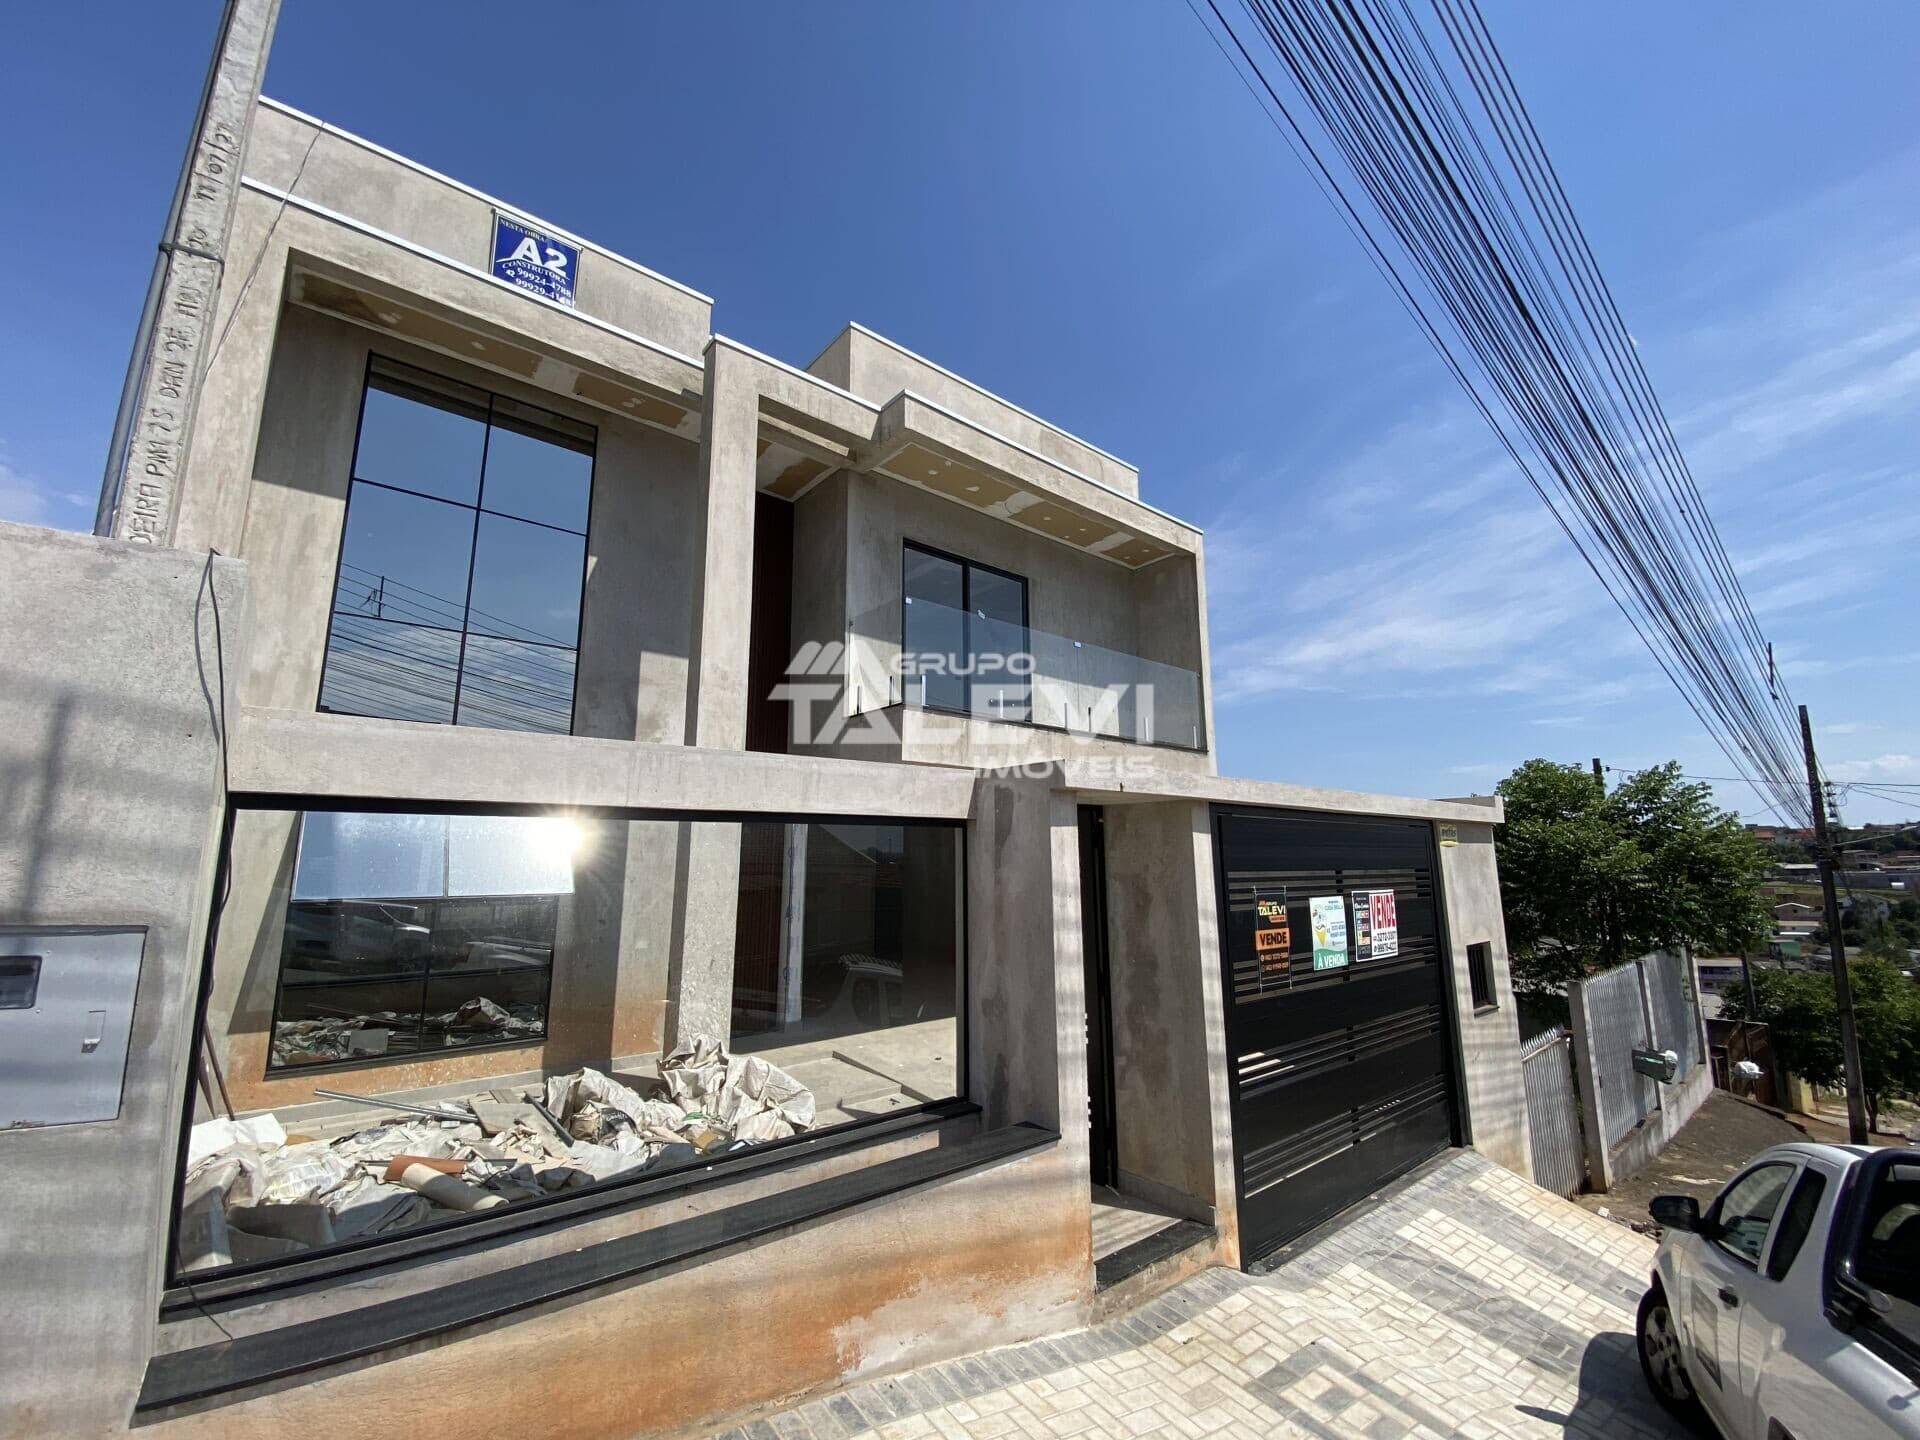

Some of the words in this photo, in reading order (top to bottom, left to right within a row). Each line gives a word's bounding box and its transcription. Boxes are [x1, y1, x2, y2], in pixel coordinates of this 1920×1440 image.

[496, 236, 570, 281] A2
[502, 260, 566, 285] CONSTRUTORA
[1257, 905, 1287, 917] TALEVI
[1259, 931, 1288, 946] VENDE
[1324, 953, 1346, 968] VENDA
